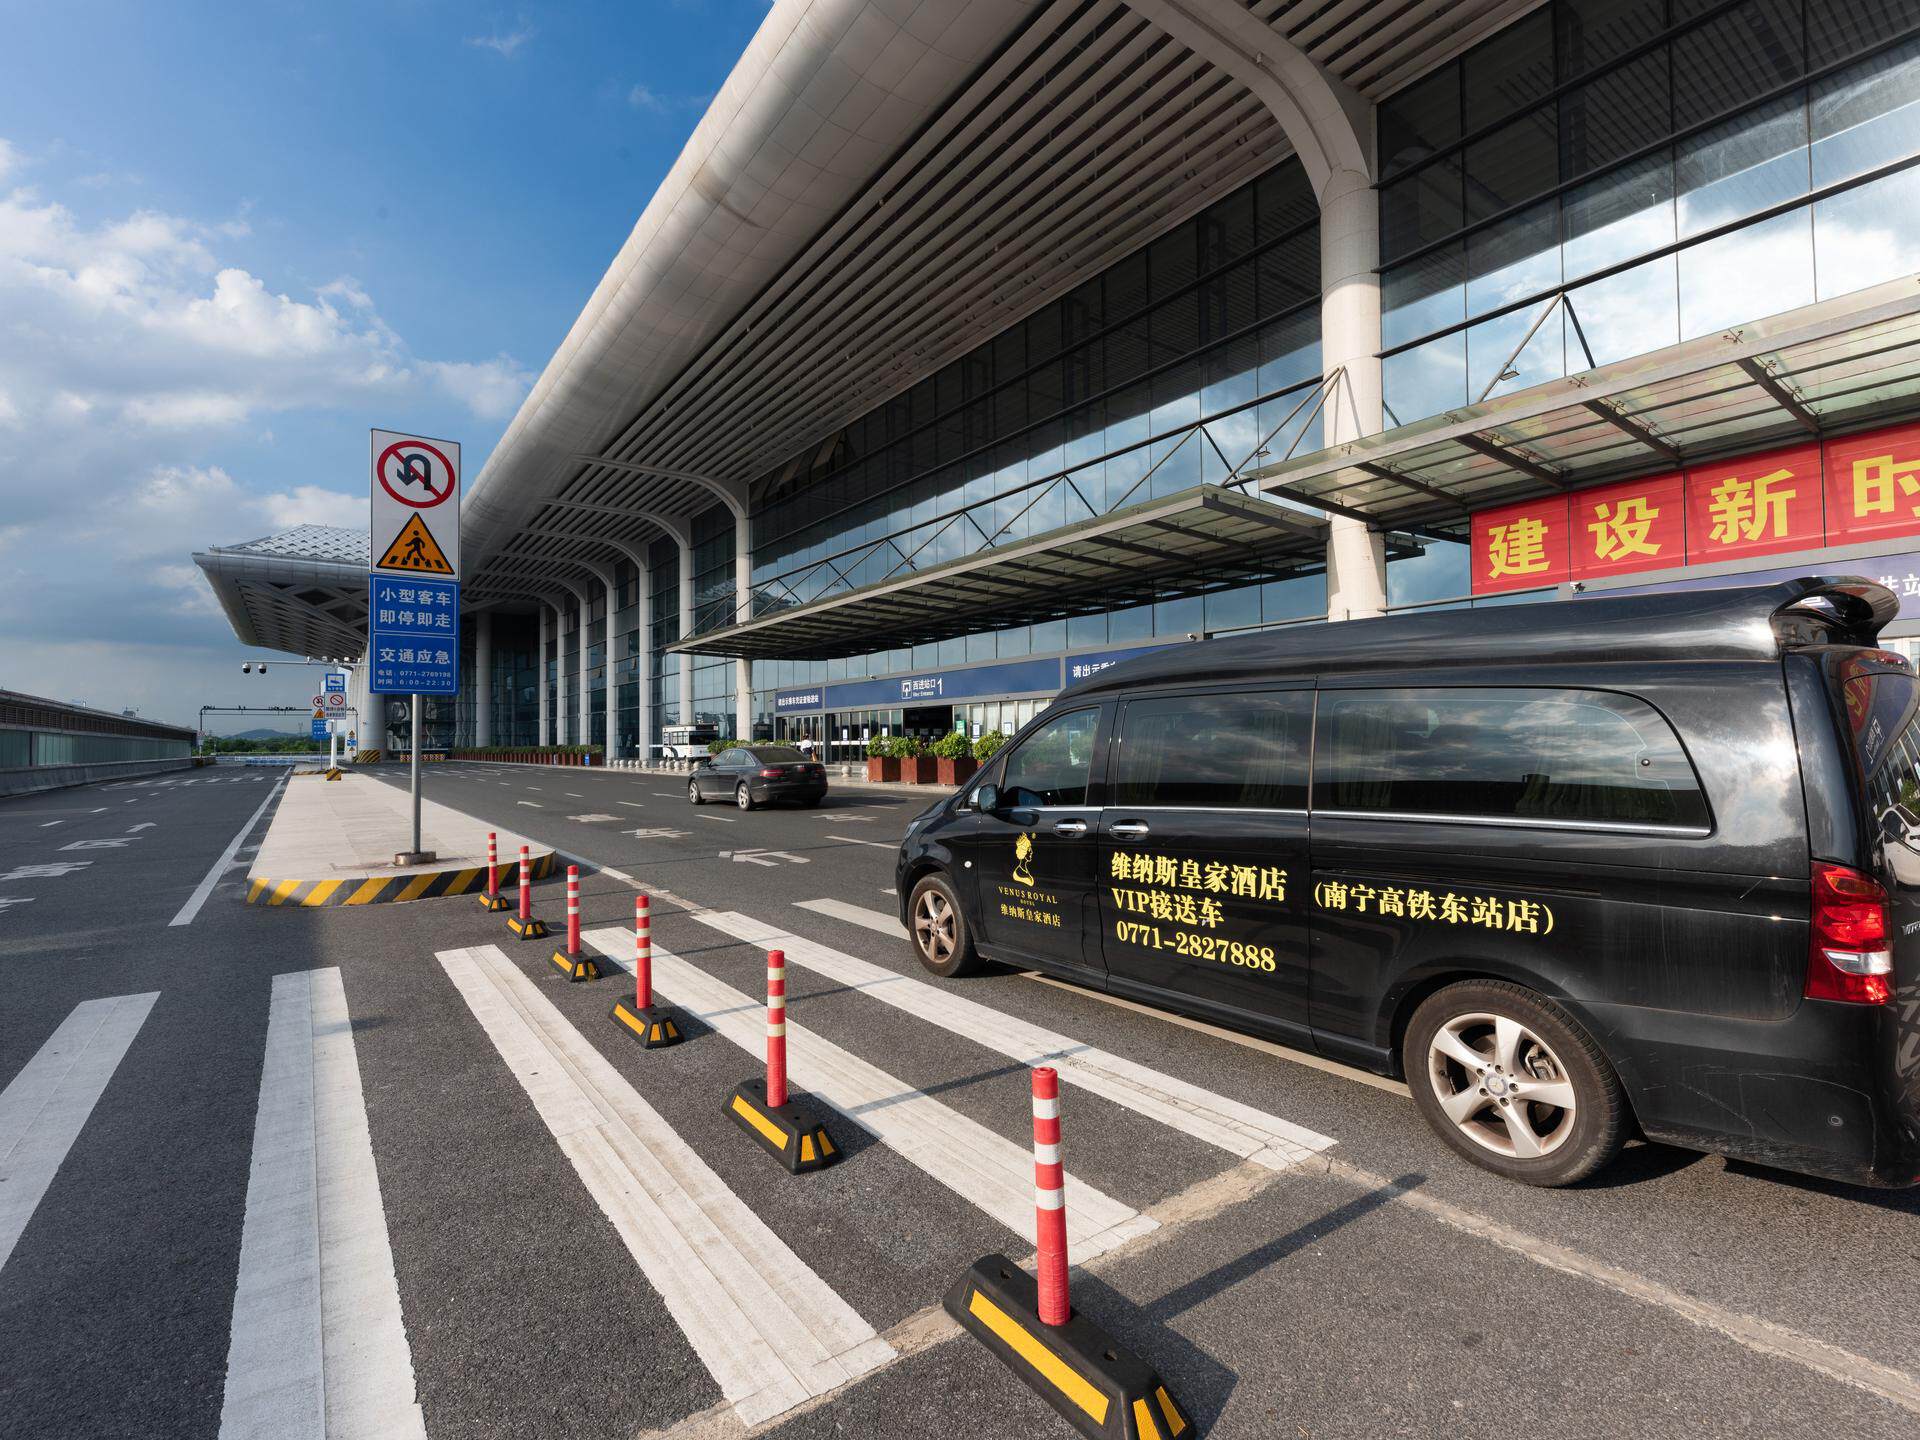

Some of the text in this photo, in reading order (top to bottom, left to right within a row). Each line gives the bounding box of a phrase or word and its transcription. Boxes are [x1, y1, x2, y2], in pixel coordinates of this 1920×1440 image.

[380, 587, 451, 606] 小型客车
[379, 609, 451, 628] 即停即走
[379, 647, 451, 665] 交通应急
[1111, 851, 1288, 902] 维纳斯皇家酒店
[1000, 903, 1061, 928] 维纳斯皇家酒店
[1111, 887, 1225, 929] VIP接送车
[1314, 881, 1554, 936] (南宁高铁东站店)
[1116, 920, 1277, 972] 0771-2827888
